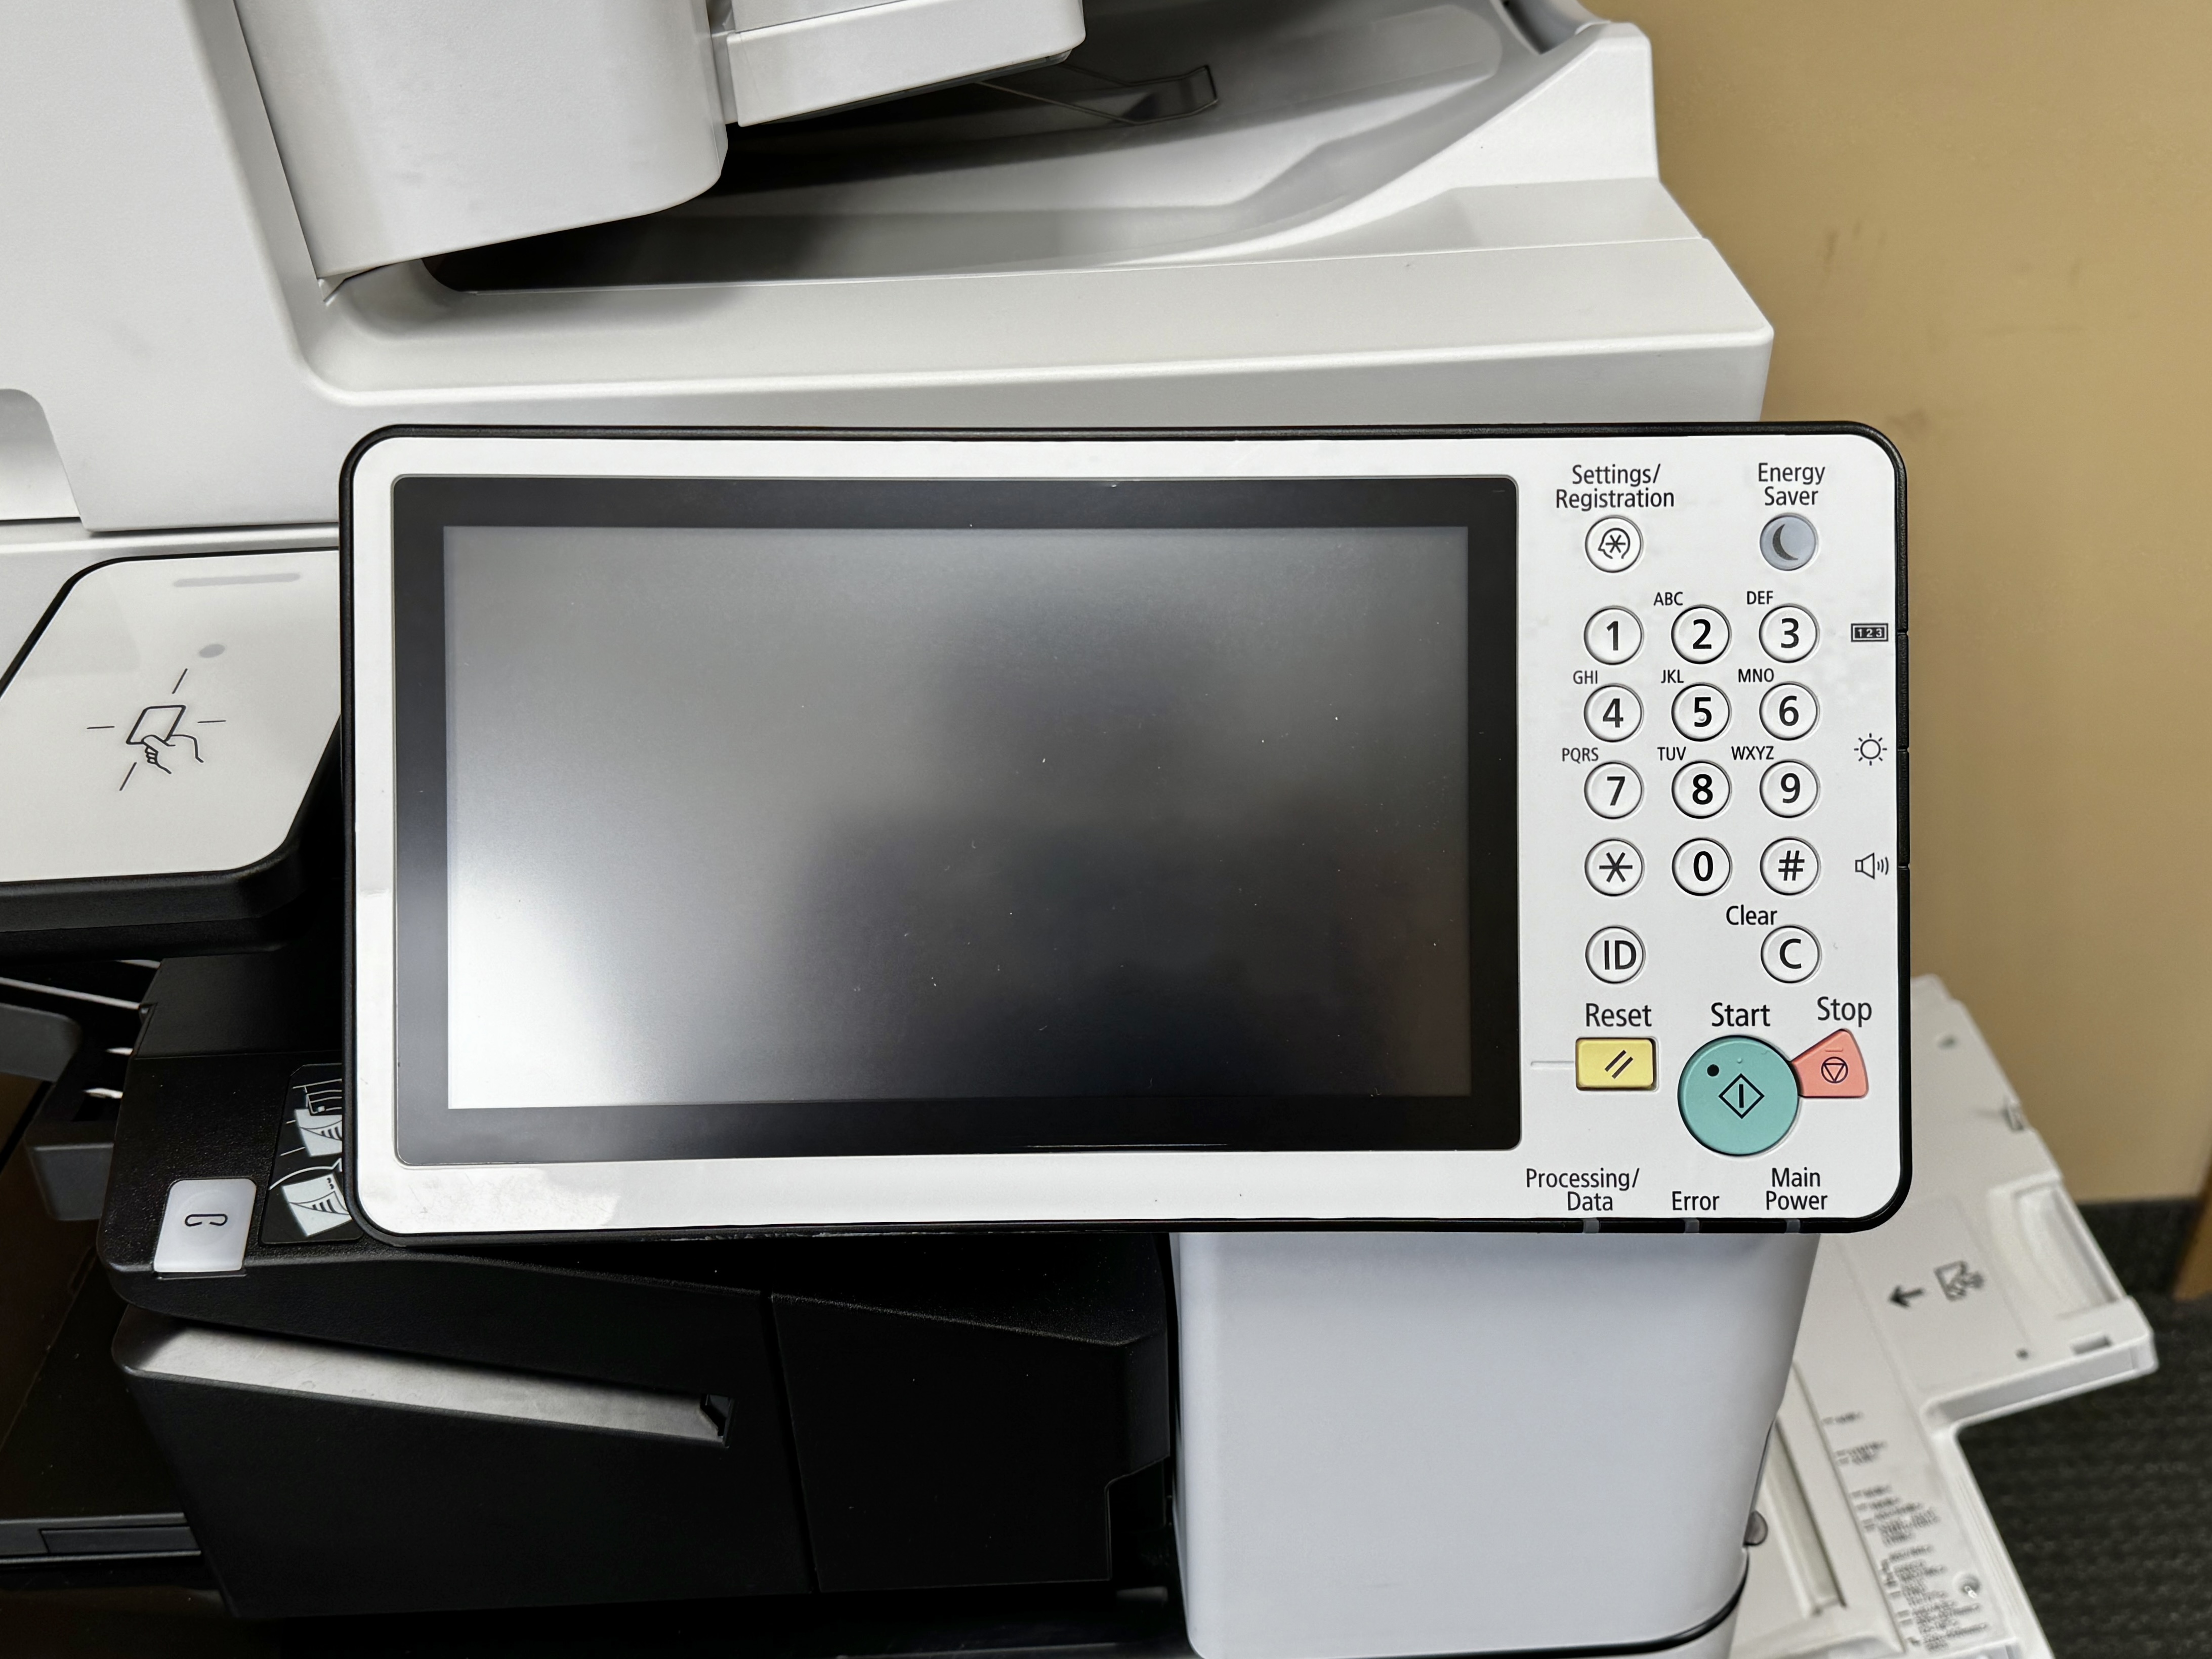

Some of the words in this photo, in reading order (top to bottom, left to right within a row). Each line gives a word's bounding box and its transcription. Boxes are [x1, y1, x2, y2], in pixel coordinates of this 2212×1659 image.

[1572, 463, 1661, 485] Settings/
[1758, 463, 1825, 485] Energy
[1556, 489, 1674, 511] Registration
[1764, 486, 1818, 506] Saver
[1653, 591, 1683, 606] ABC
[1746, 590, 1773, 605] DEF
[1606, 620, 1618, 651] 1
[1692, 618, 1712, 649] 2
[1781, 617, 1799, 649] 3
[1573, 670, 1598, 685] GHI
[1661, 669, 1684, 684] JKL
[1738, 668, 1774, 683] MNO
[1602, 698, 1624, 728] 4
[1694, 696, 1712, 727] 5
[1779, 695, 1799, 726] 6
[1562, 748, 1599, 763] PQRS
[1657, 746, 1686, 761] TUV
[1731, 745, 1774, 760] WXYZ
[1607, 776, 1625, 806] 7
[1692, 774, 1713, 805] 8
[1780, 773, 1801, 804] 9
[1693, 851, 1714, 882] 0
[1778, 850, 1805, 881] #
[1726, 904, 1778, 926] Clear
[1603, 940, 1637, 970] ID
[1779, 938, 1802, 969] C
[1586, 1003, 1652, 1027] Reset
[1711, 1002, 1771, 1027] Start
[1817, 996, 1872, 1027] Stop
[1526, 1168, 1640, 1191] Processing/
[1772, 1167, 1820, 1187] Main
[1567, 1191, 1613, 1211] Data
[1672, 1191, 1720, 1211] Error
[1766, 1190, 1828, 1210] Power
